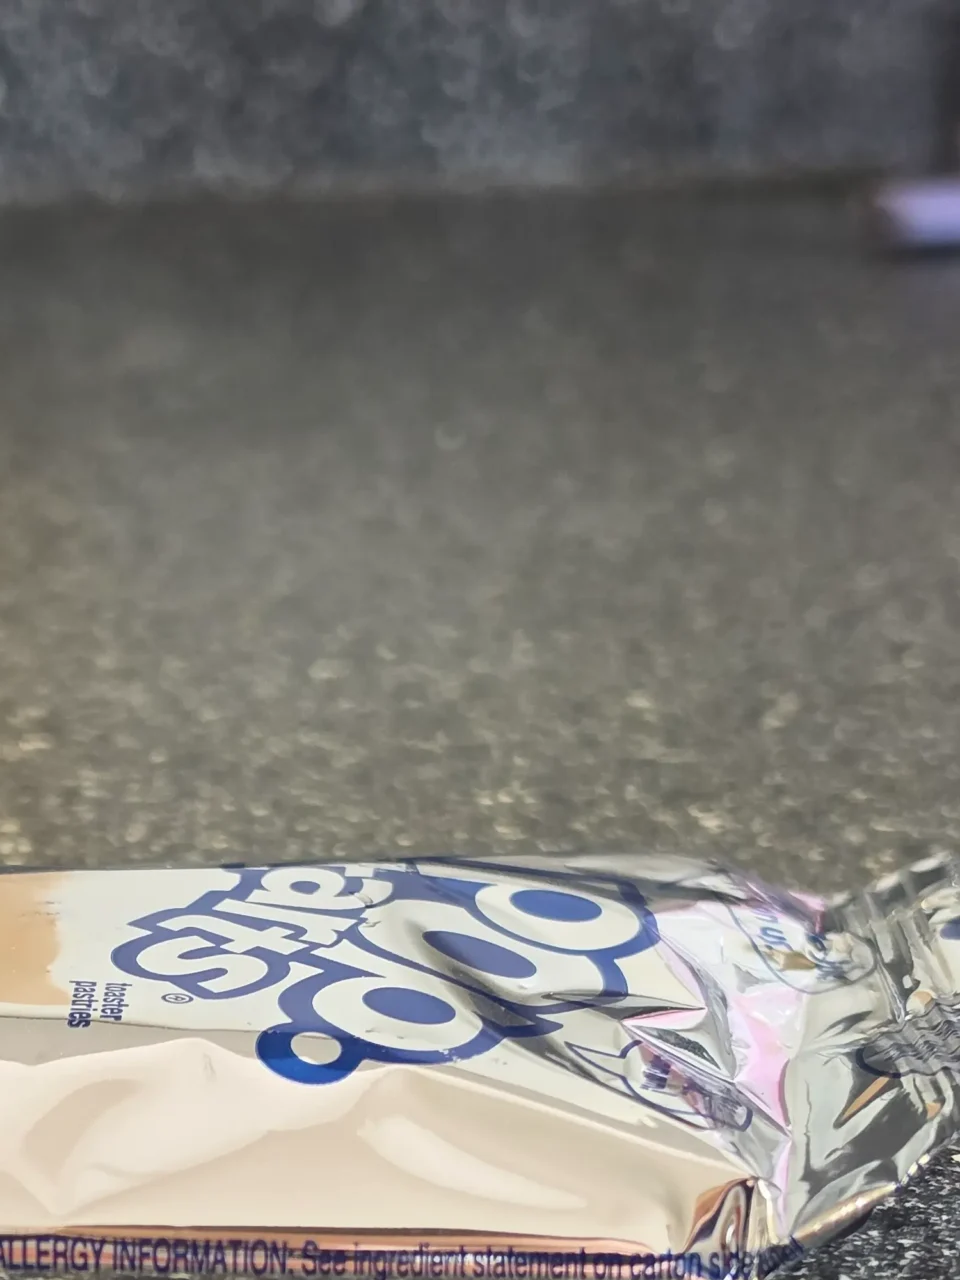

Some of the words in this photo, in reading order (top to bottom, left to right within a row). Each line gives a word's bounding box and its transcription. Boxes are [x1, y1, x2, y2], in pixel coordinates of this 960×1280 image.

[68, 980, 99, 1029] pastries
[100, 983, 133, 1021] toaster
[301, 1239, 345, 1276] See
[473, 1244, 586, 1280] statement
[593, 1253, 622, 1280] on
[631, 1247, 702, 1280] carton
